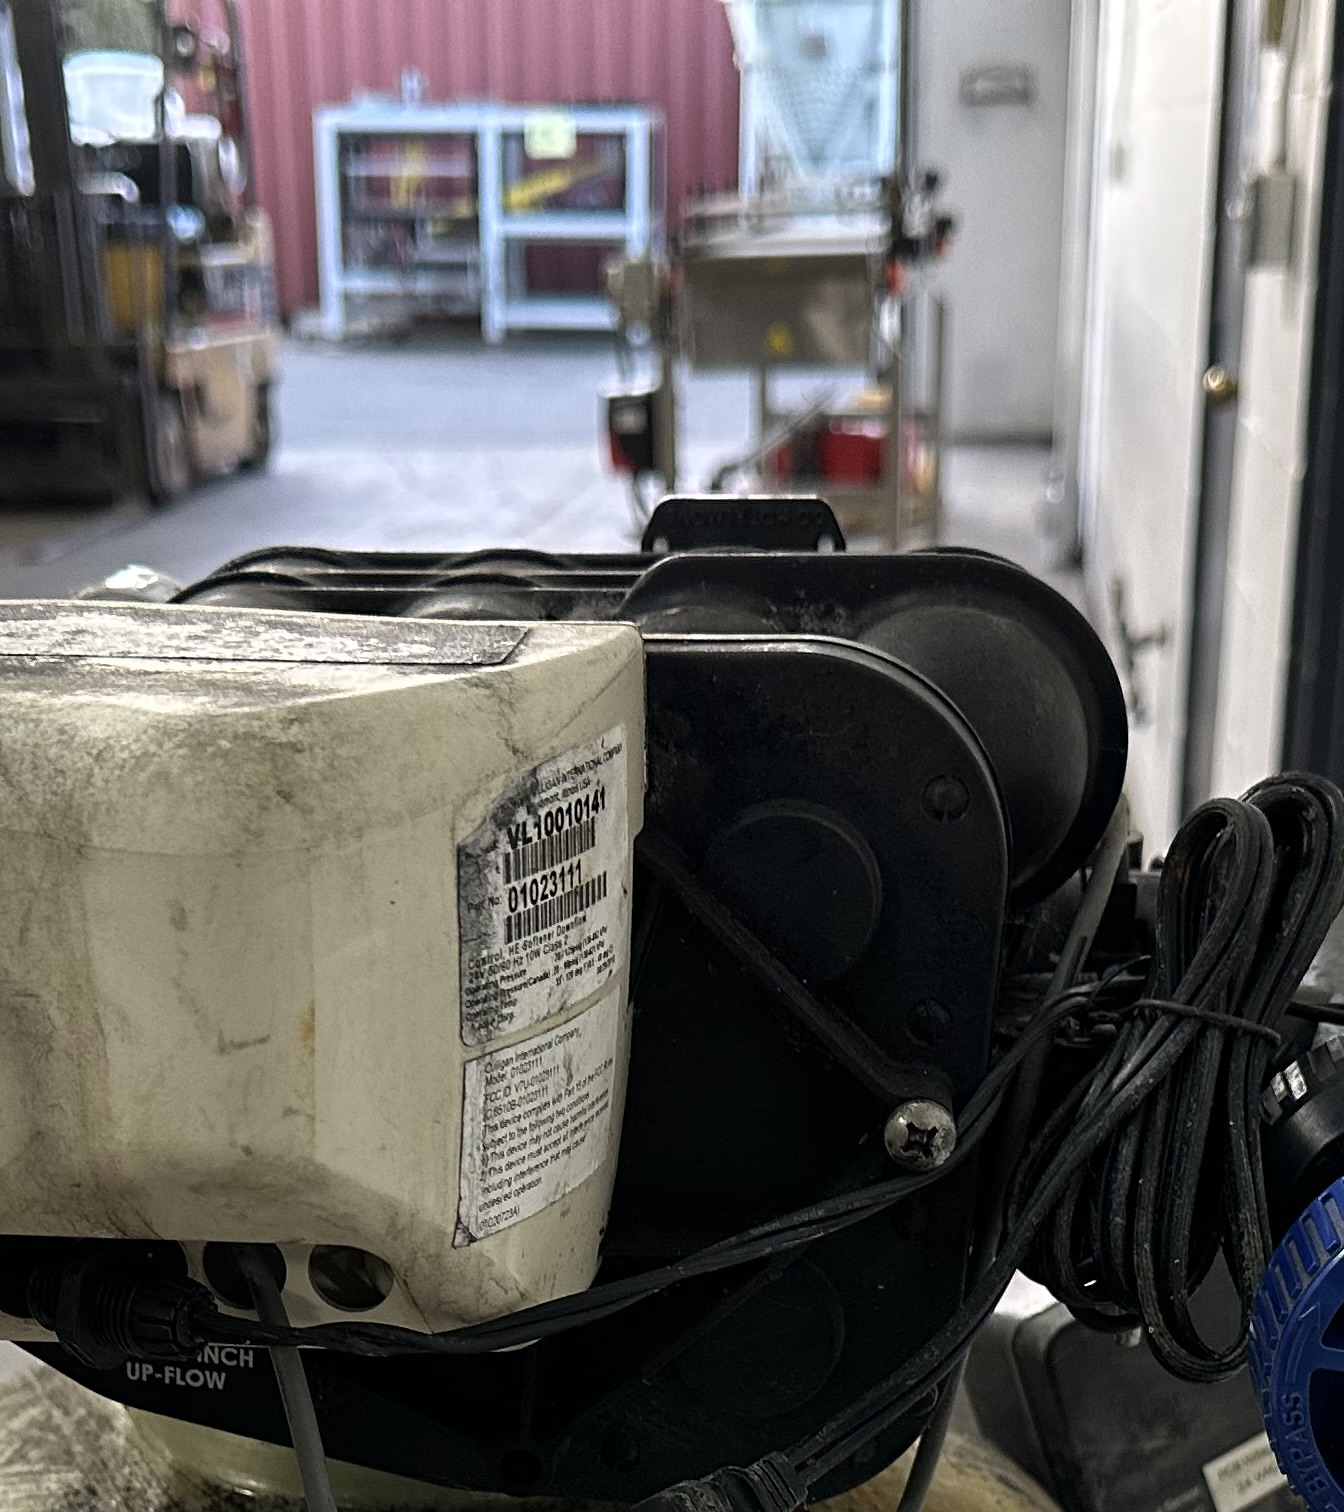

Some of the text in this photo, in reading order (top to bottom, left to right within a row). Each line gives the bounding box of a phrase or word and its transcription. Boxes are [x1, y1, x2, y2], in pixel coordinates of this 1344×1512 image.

[507, 786, 605, 850] VL10010141
[508, 859, 582, 913] 01023111
[509, 943, 519, 956] HE
[523, 932, 553, 950] Softener
[514, 1039, 553, 1061] International
[483, 1090, 501, 1106] FCC
[516, 1127, 527, 1137] the
[506, 1141, 527, 1156] device
[488, 1166, 502, 1177] This
[504, 1156, 525, 1171] device
[126, 1361, 227, 1391] UP-FLOW
[1280, 1391, 1331, 1495] BYPASS
